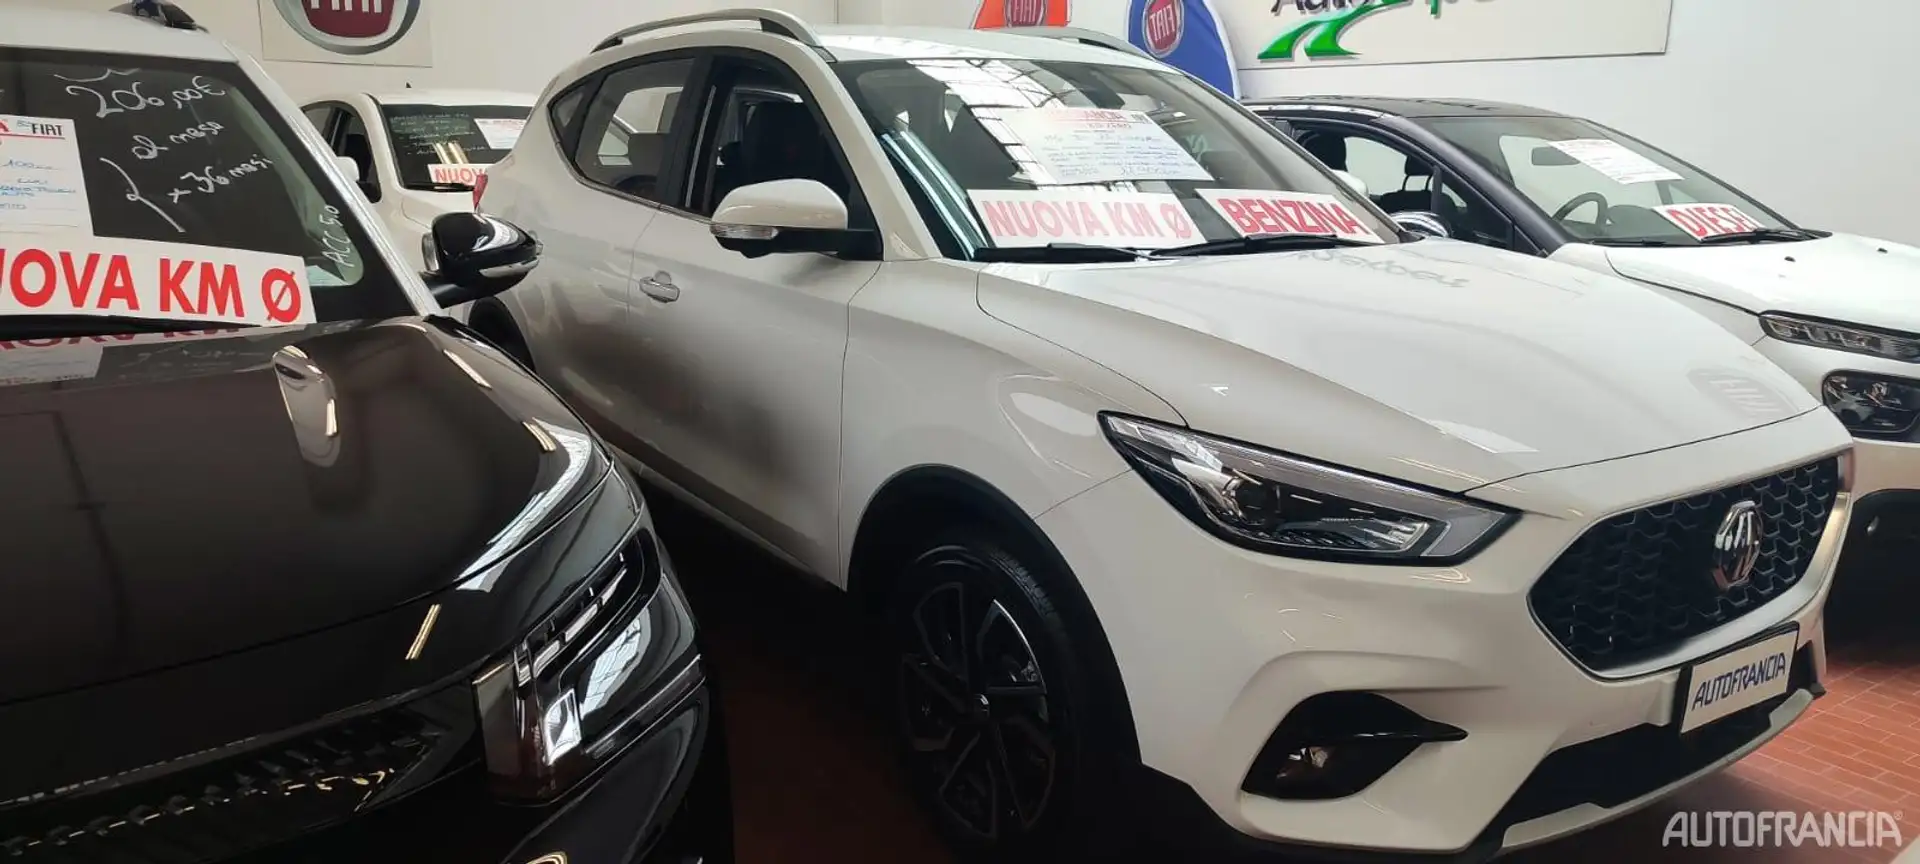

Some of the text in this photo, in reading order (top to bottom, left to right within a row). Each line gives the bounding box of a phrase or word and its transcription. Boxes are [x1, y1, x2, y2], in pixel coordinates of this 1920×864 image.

[31, 123, 64, 136] FIAT
[982, 200, 1110, 238] NUOVA
[1102, 201, 1166, 237] KM
[1216, 197, 1370, 235] BENZINA
[159, 257, 246, 318] KM
[1691, 652, 1786, 711] AUTOFRANCIA
